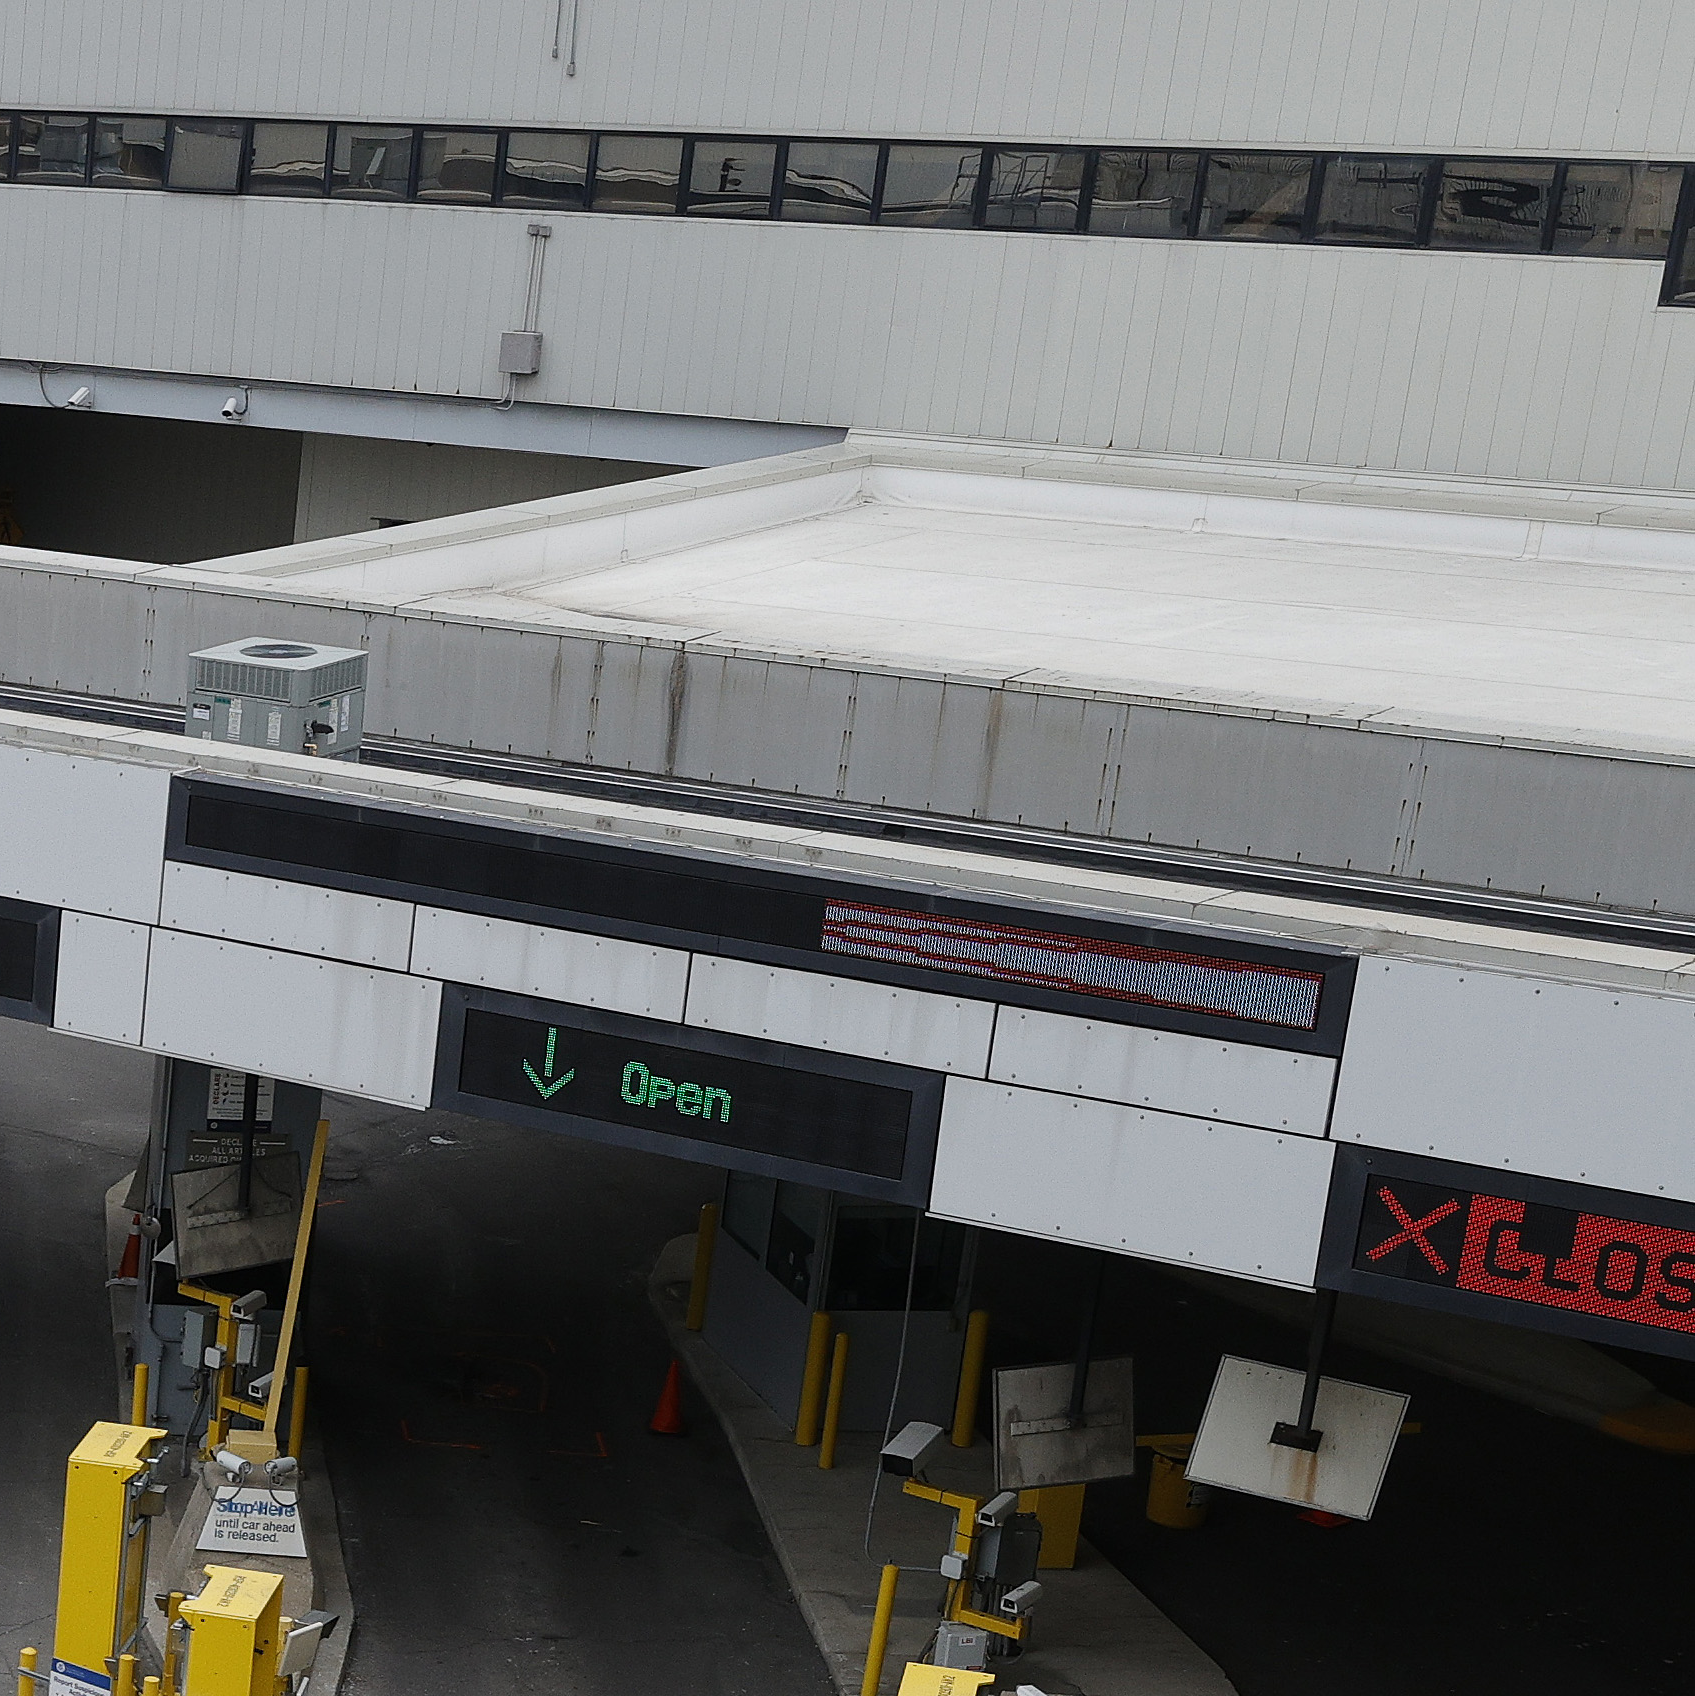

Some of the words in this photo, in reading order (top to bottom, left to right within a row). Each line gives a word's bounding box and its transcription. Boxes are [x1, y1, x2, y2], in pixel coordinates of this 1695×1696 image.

[621, 1060, 732, 1123] Open
[216, 1519, 239, 1529] until
[263, 1522, 295, 1533] ahead
[215, 1529, 224, 1538] is
[228, 1530, 279, 1542] released.
